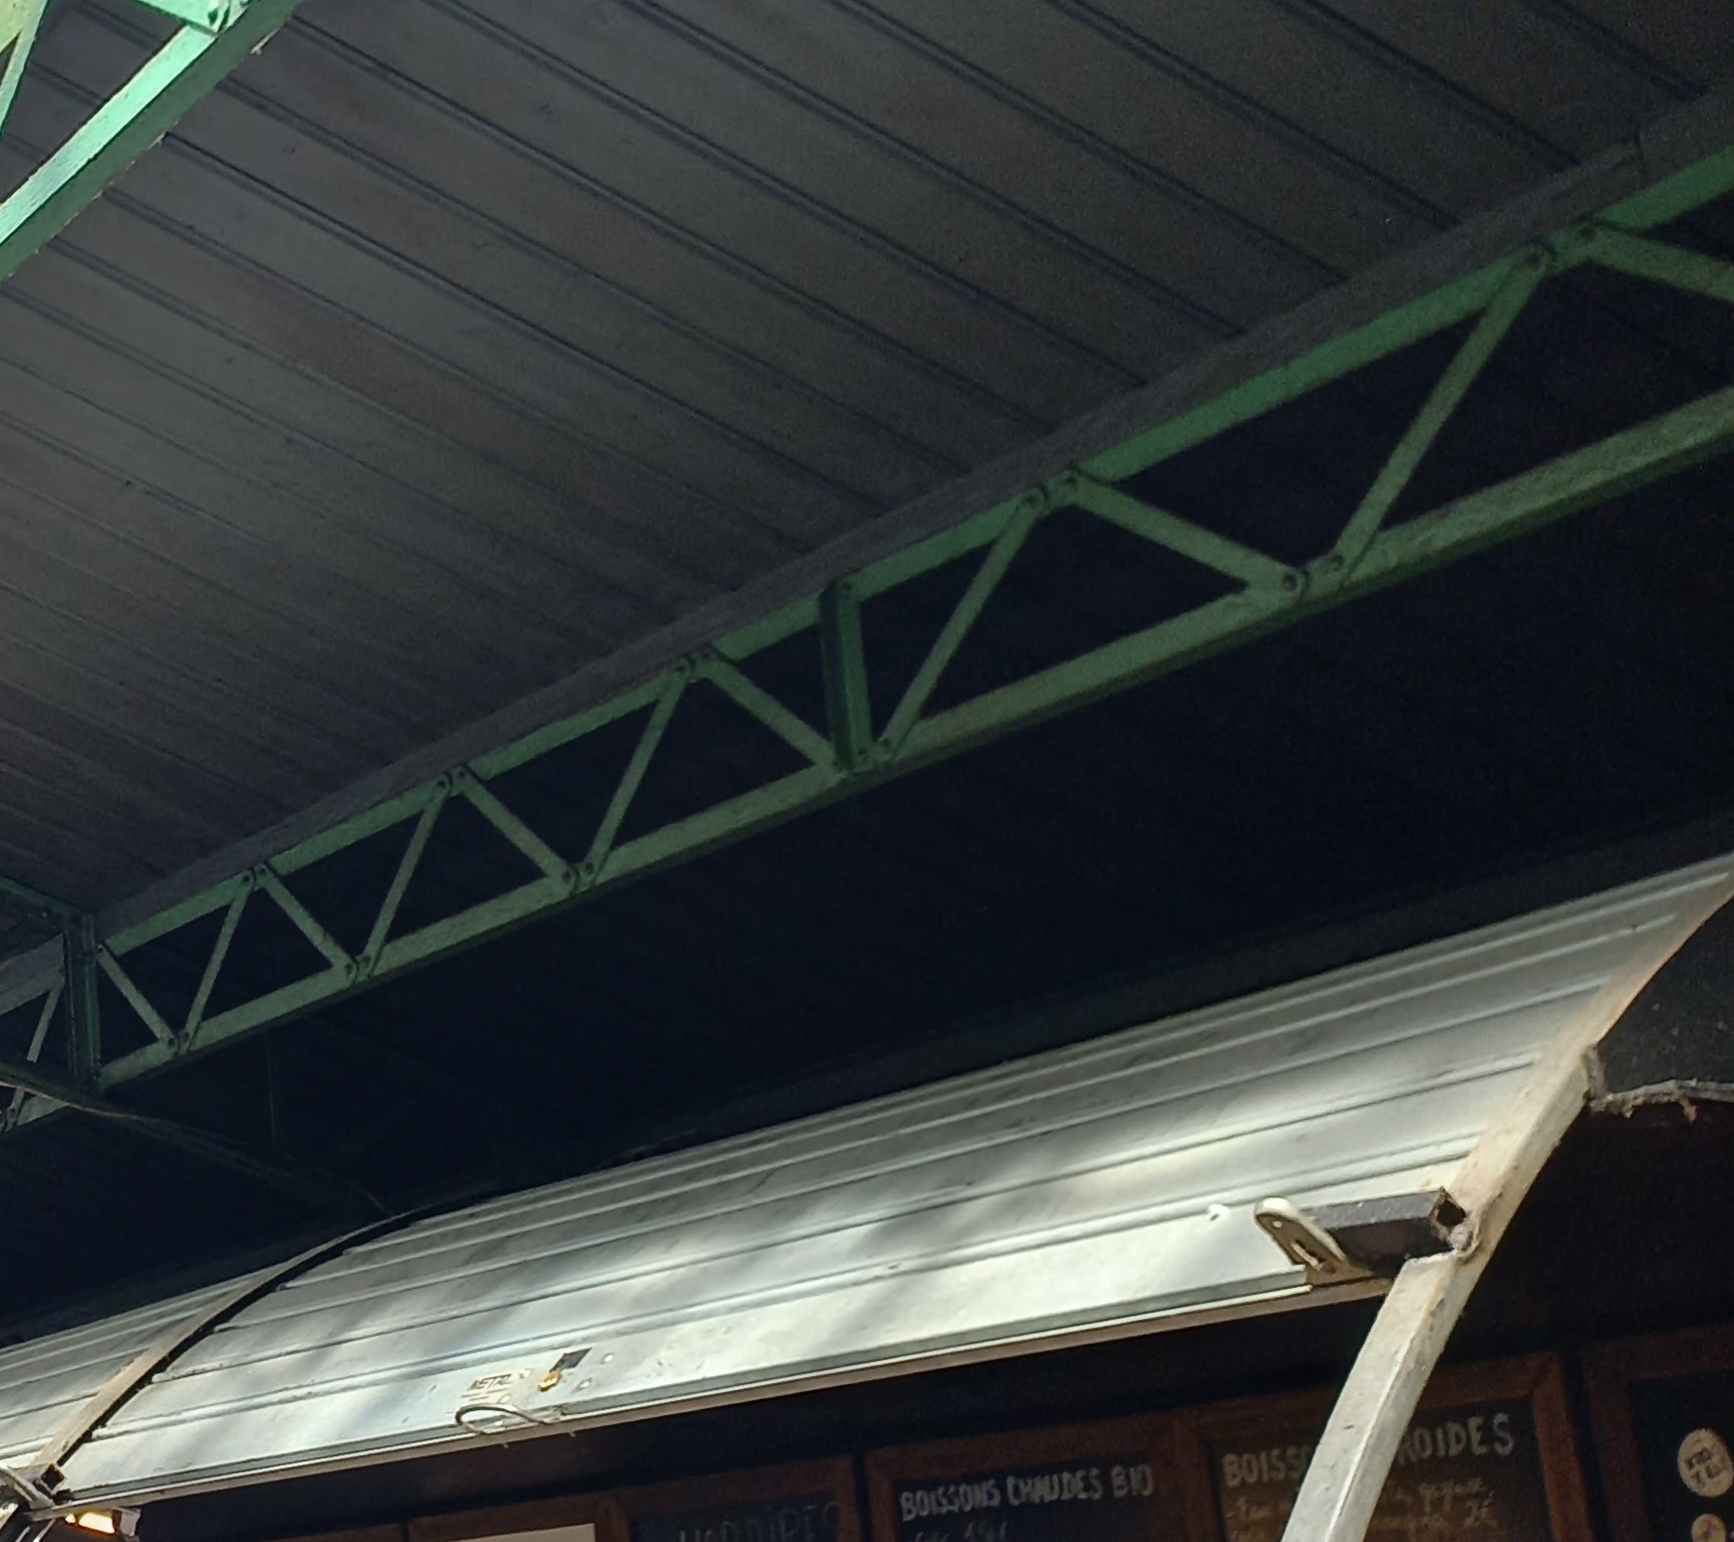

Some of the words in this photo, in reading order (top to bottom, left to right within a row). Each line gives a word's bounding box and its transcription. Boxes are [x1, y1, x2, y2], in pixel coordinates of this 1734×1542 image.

[1398, 1411, 1515, 1467] ROIDES
[899, 1477, 1003, 1523] BOISSONS
[1005, 1465, 1104, 1506] CHAUDES
[1110, 1463, 1155, 1499] BIO
